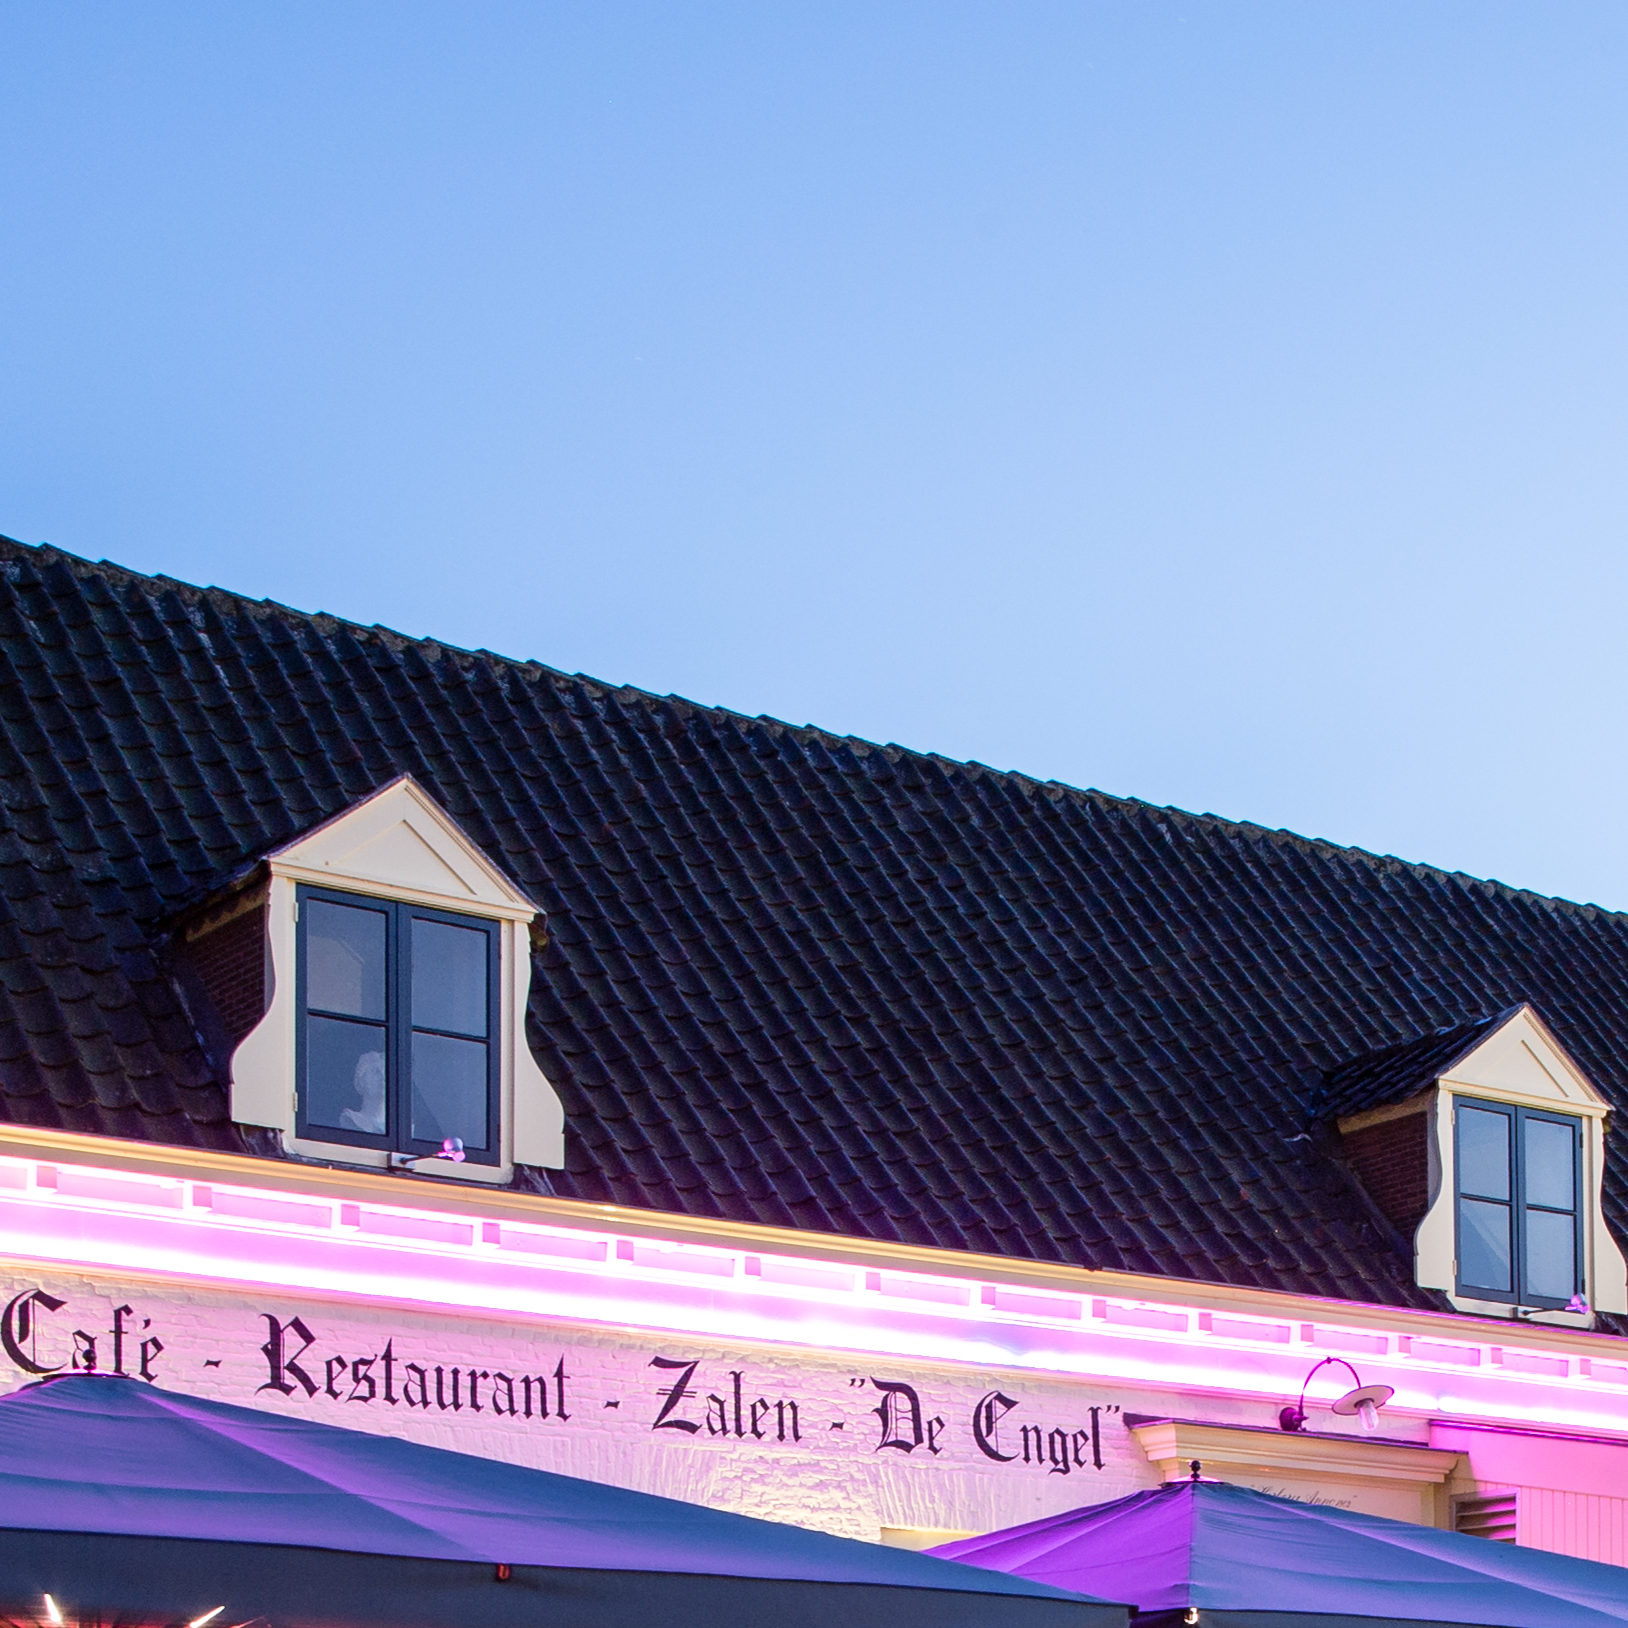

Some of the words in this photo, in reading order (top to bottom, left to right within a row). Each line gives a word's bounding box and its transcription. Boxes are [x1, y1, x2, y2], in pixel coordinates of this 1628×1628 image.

[0, 1288, 165, 1382] Café
[255, 1312, 573, 1423] Restaurant
[648, 1355, 803, 1443] Zalen
